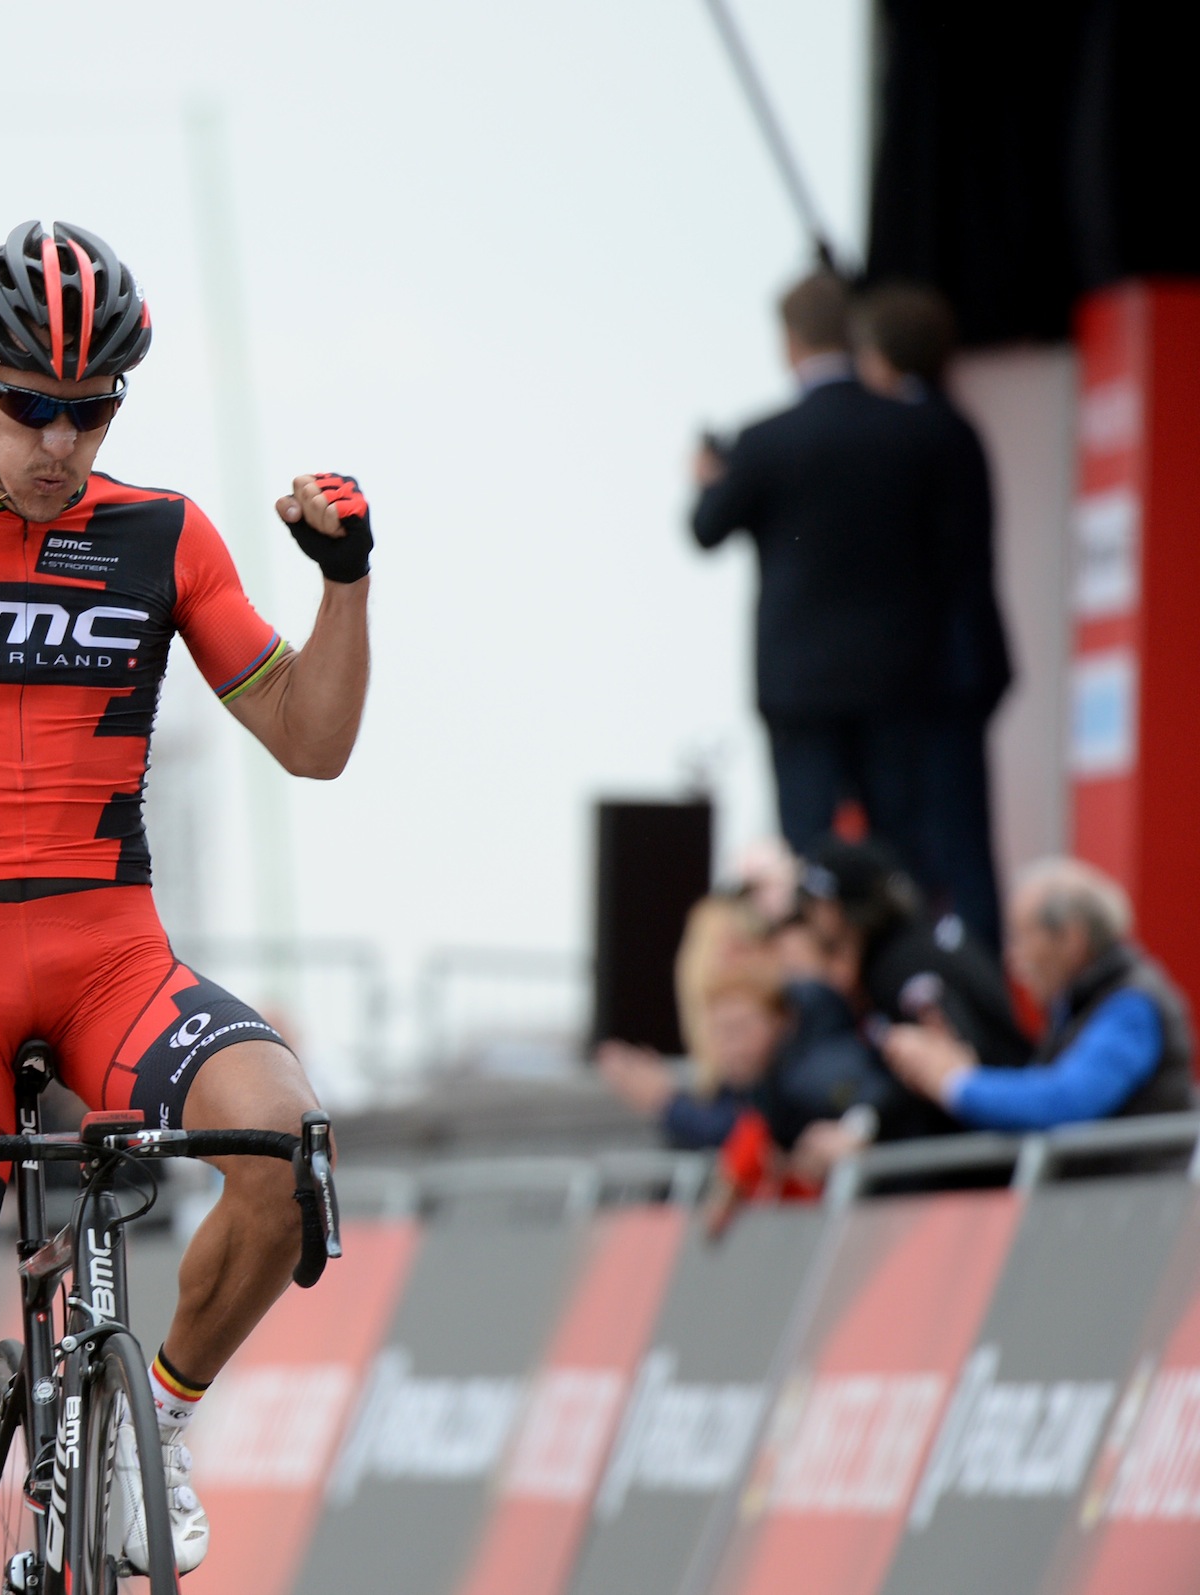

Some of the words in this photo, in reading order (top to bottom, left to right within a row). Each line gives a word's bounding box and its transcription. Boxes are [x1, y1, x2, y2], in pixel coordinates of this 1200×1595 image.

[44, 551, 119, 563] bergamont
[47, 538, 93, 551] BMC
[87, 1228, 116, 1318] BMC
[65, 1396, 82, 1470] BMC
